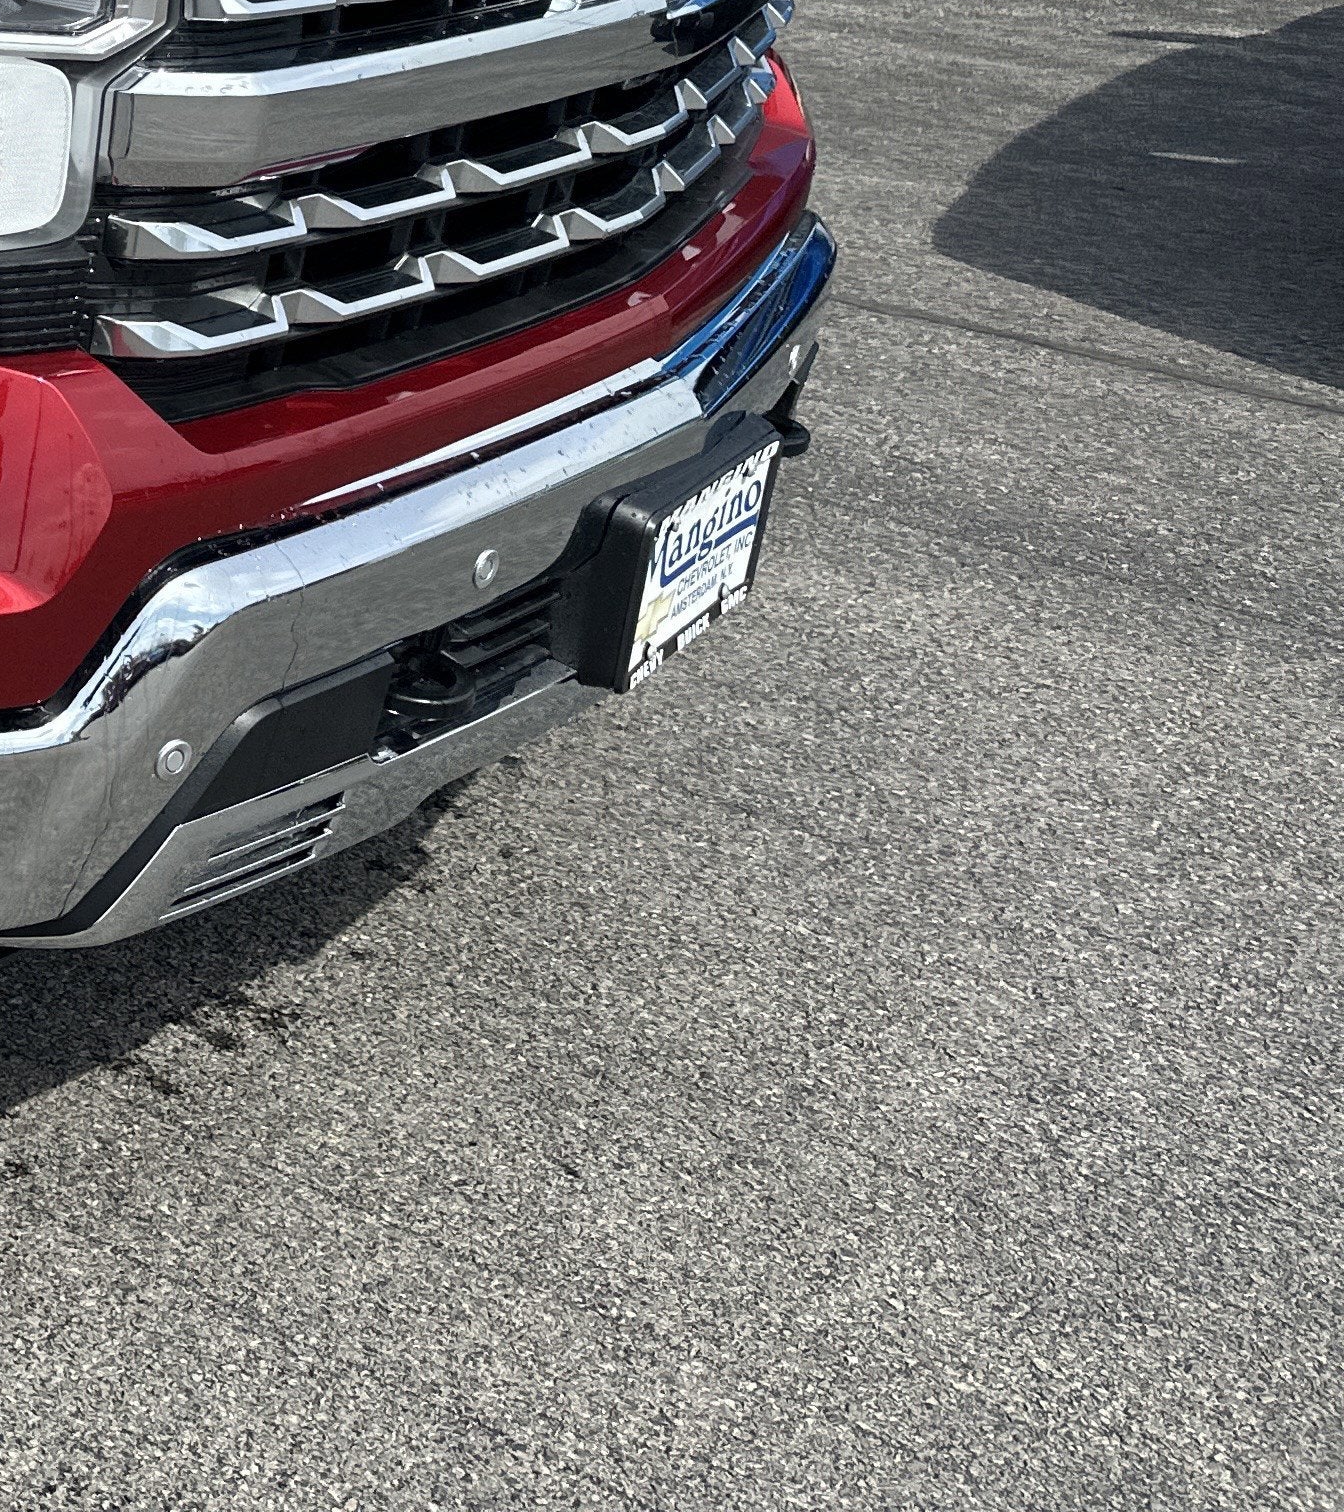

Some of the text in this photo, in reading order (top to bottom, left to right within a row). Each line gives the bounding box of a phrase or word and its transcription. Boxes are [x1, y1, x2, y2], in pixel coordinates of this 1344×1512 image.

[648, 479, 762, 587] Mangino
[630, 585, 748, 690] CHEVY BUICK GMC
